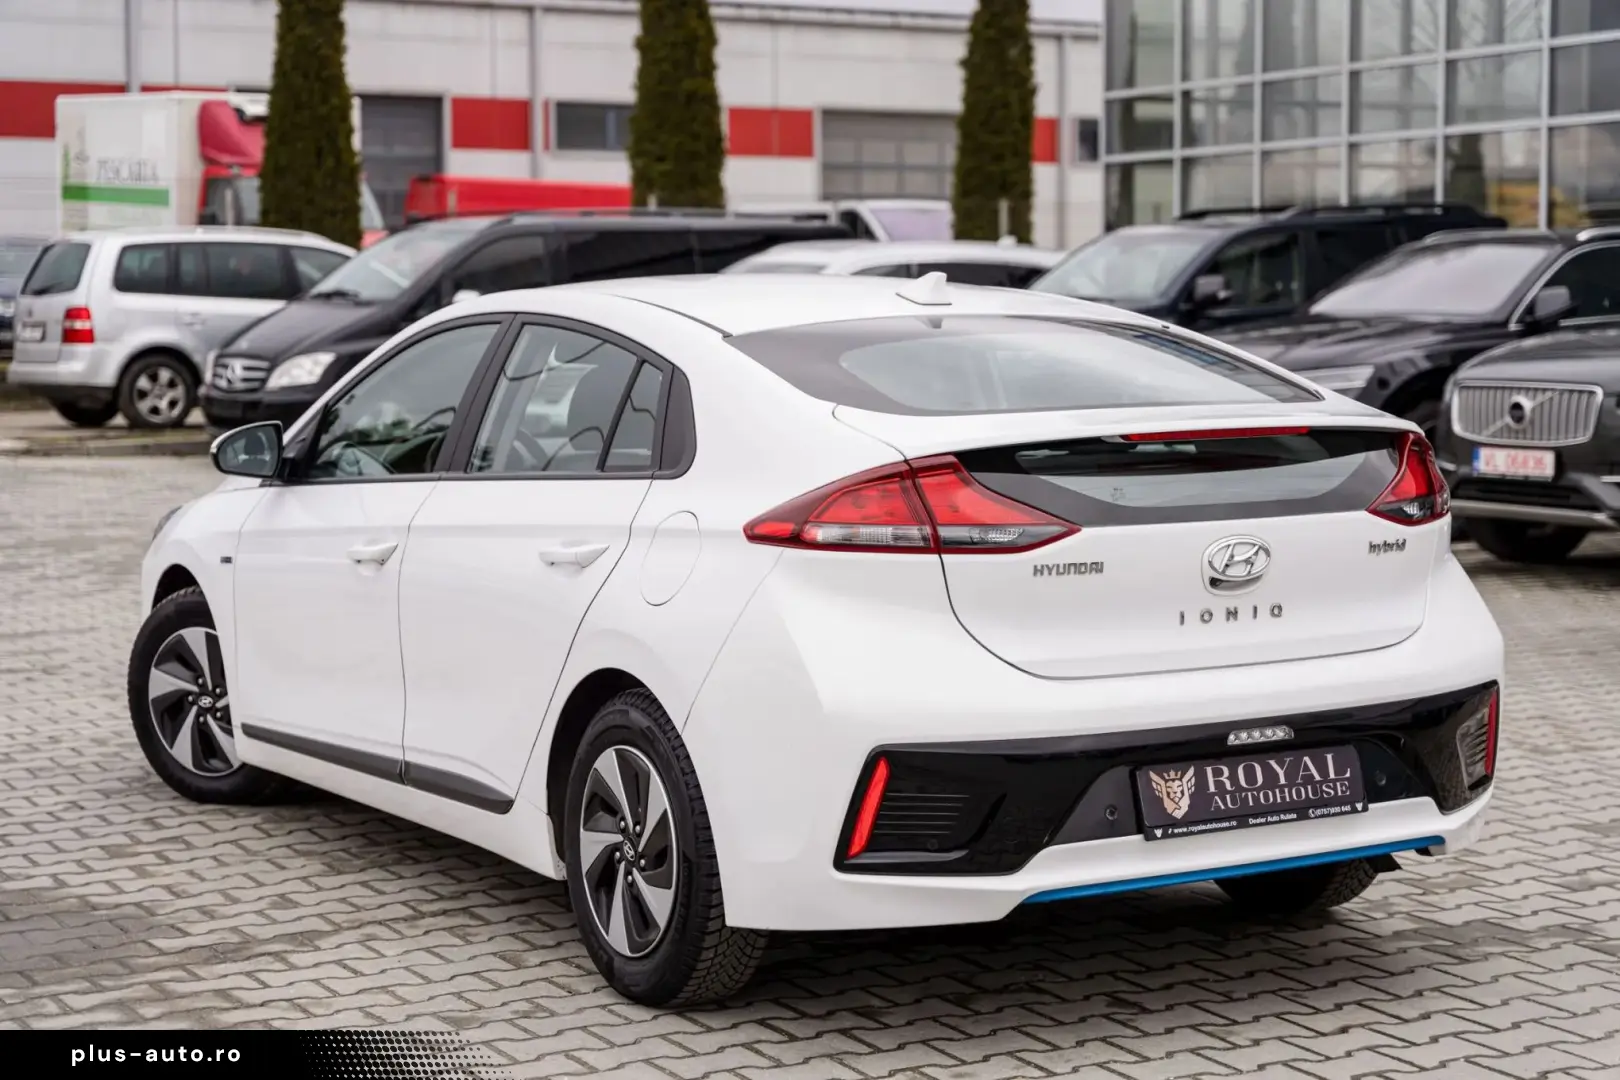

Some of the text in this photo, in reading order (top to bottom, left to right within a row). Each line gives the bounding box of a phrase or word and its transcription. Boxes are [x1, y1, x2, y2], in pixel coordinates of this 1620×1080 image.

[1368, 538, 1407, 556] hybrid
[1033, 561, 1105, 577] HYUNDAI
[1178, 602, 1284, 626] IONIQ
[1204, 753, 1351, 793] ROYAL
[1210, 780, 1350, 811] AUTOHOUSE
[1248, 816, 1267, 825] Dealer
[1267, 814, 1280, 823] Auto
